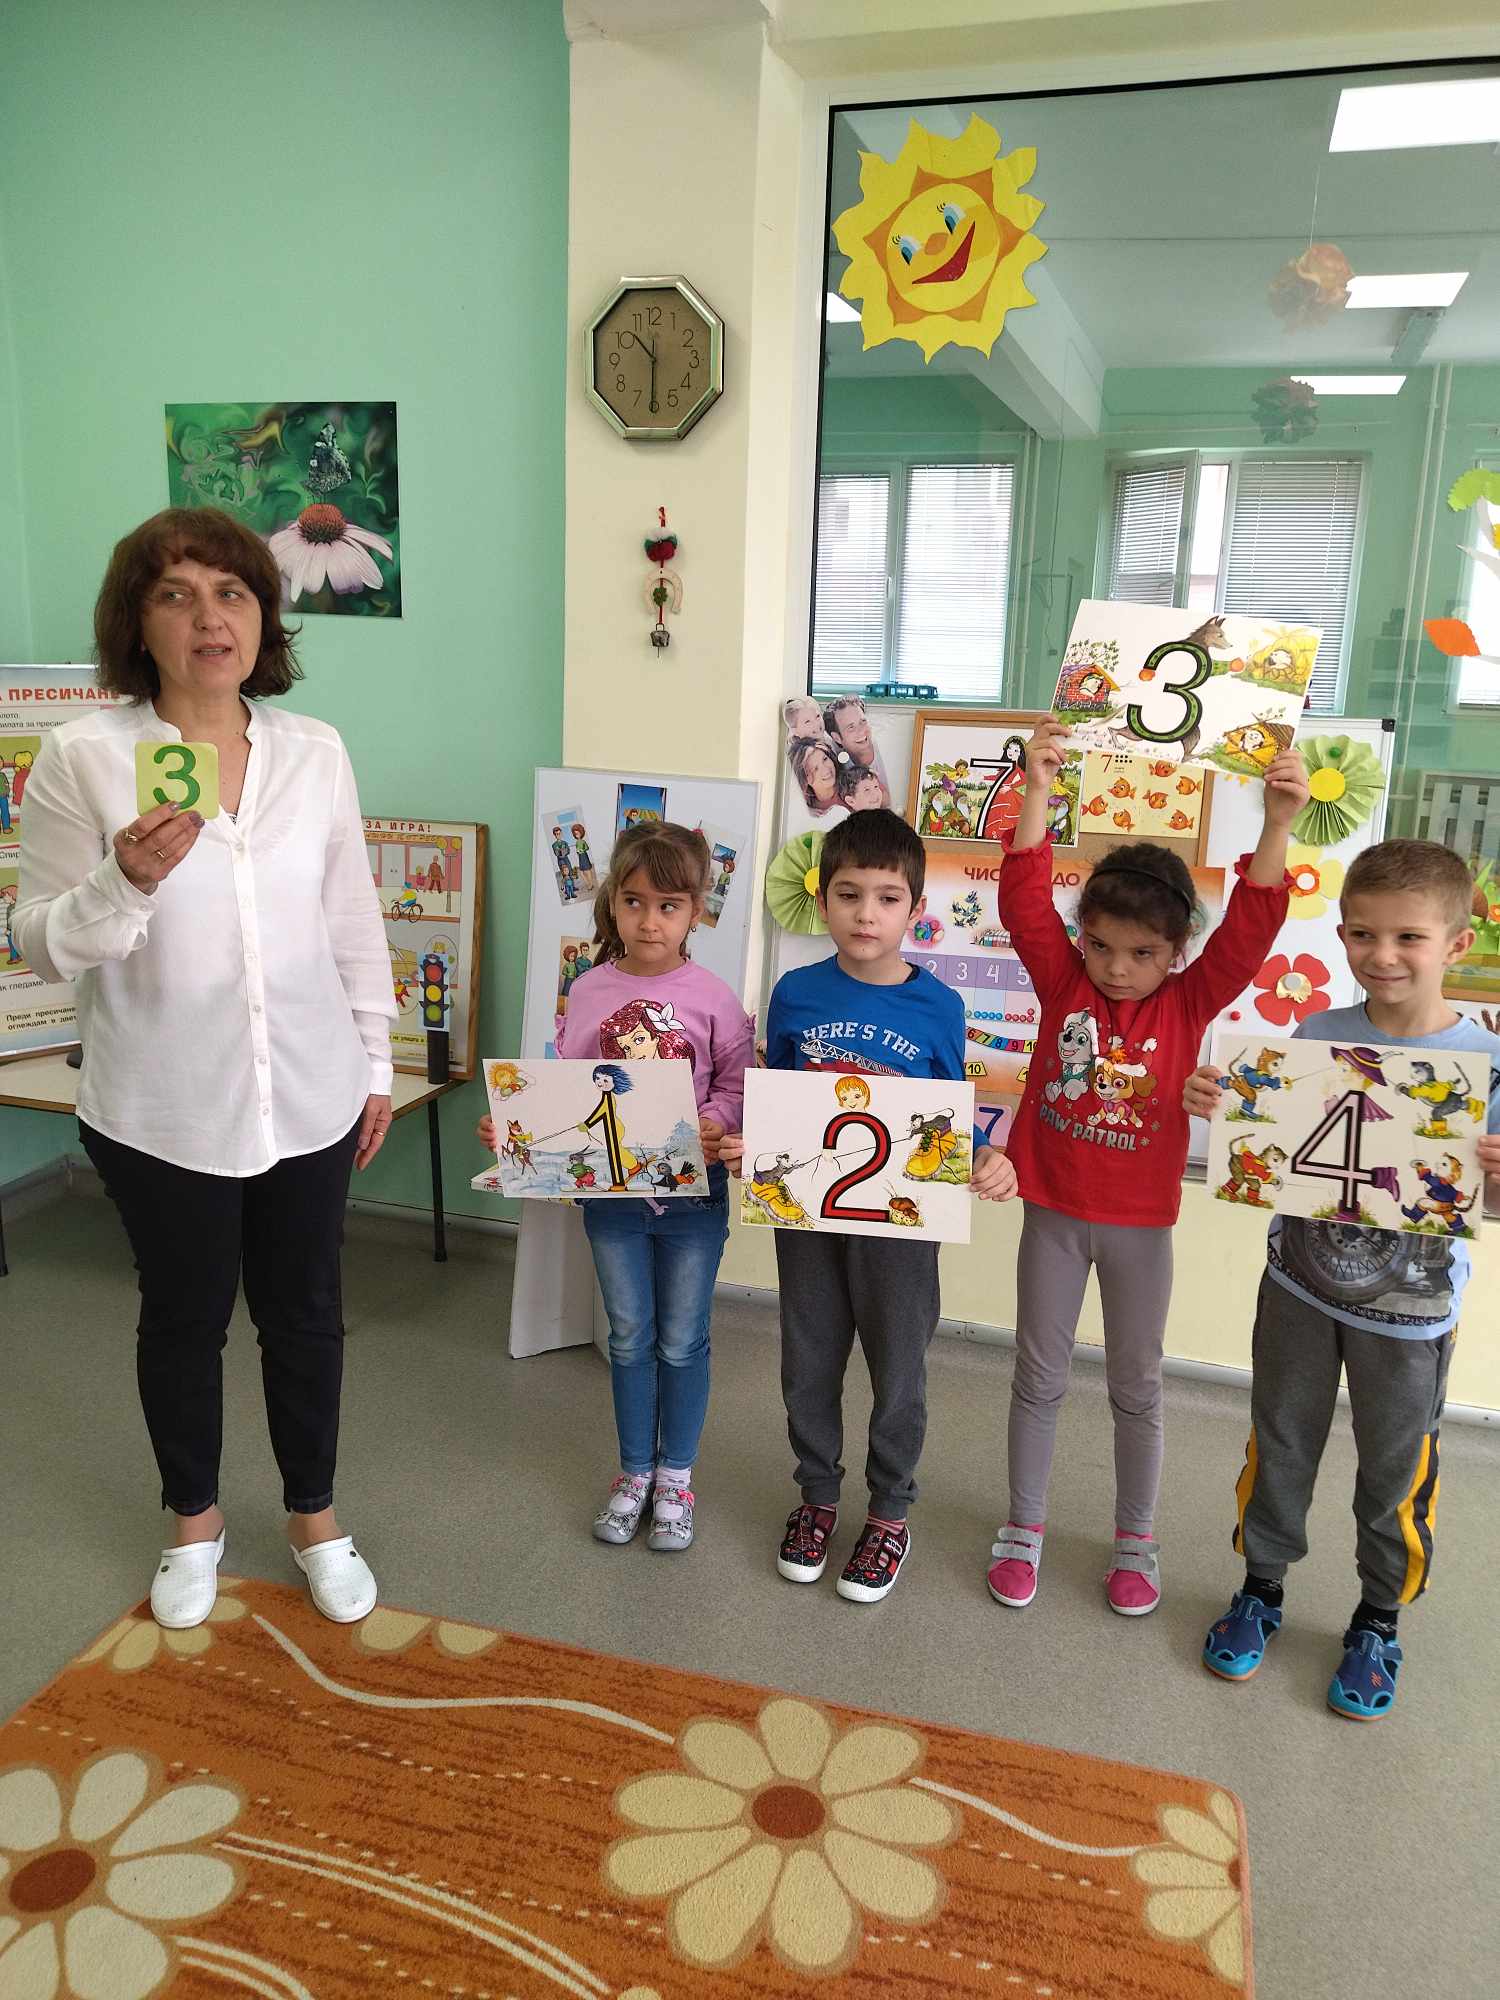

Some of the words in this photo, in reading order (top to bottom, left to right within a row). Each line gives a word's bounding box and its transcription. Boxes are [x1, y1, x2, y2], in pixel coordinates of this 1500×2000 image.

[632, 313, 642, 331] 11
[645, 306, 663, 326] 12
[670, 312, 676, 330] 1
[615, 331, 635, 350] 10
[682, 329, 694, 348] 2
[608, 352, 620, 370] 9
[688, 350, 700, 368] 3
[616, 374, 626, 392] 8
[680, 372, 691, 391] 4
[633, 389, 642, 407] 7
[667, 389, 679, 408] 5
[1127, 640, 1212, 743] 3
[1101, 754, 1112, 773] 7
[153, 745, 200, 810] 3
[970, 758, 1017, 839] 7
[366, 820, 382, 829] ЗА
[390, 821, 431, 833] ИГРА!
[956, 962, 969, 981] 3
[986, 963, 1000, 984] 4
[1016, 966, 1030, 986] 5
[802, 1021, 877, 1041] HERE'S
[881, 1028, 920, 1061] THE
[967, 1029, 976, 1039] 6
[981, 1033, 990, 1044] 7
[995, 1038, 1003, 1048] 8
[1011, 1041, 1019, 1051] 9
[968, 1064, 981, 1075] 10
[978, 1106, 1004, 1138] 7
[1039, 1103, 1072, 1132] PAW
[1072, 1122, 1137, 1151] PATROL
[583, 1090, 625, 1190] 1
[1290, 1089, 1375, 1210] 4
[820, 1111, 892, 1222] 2
